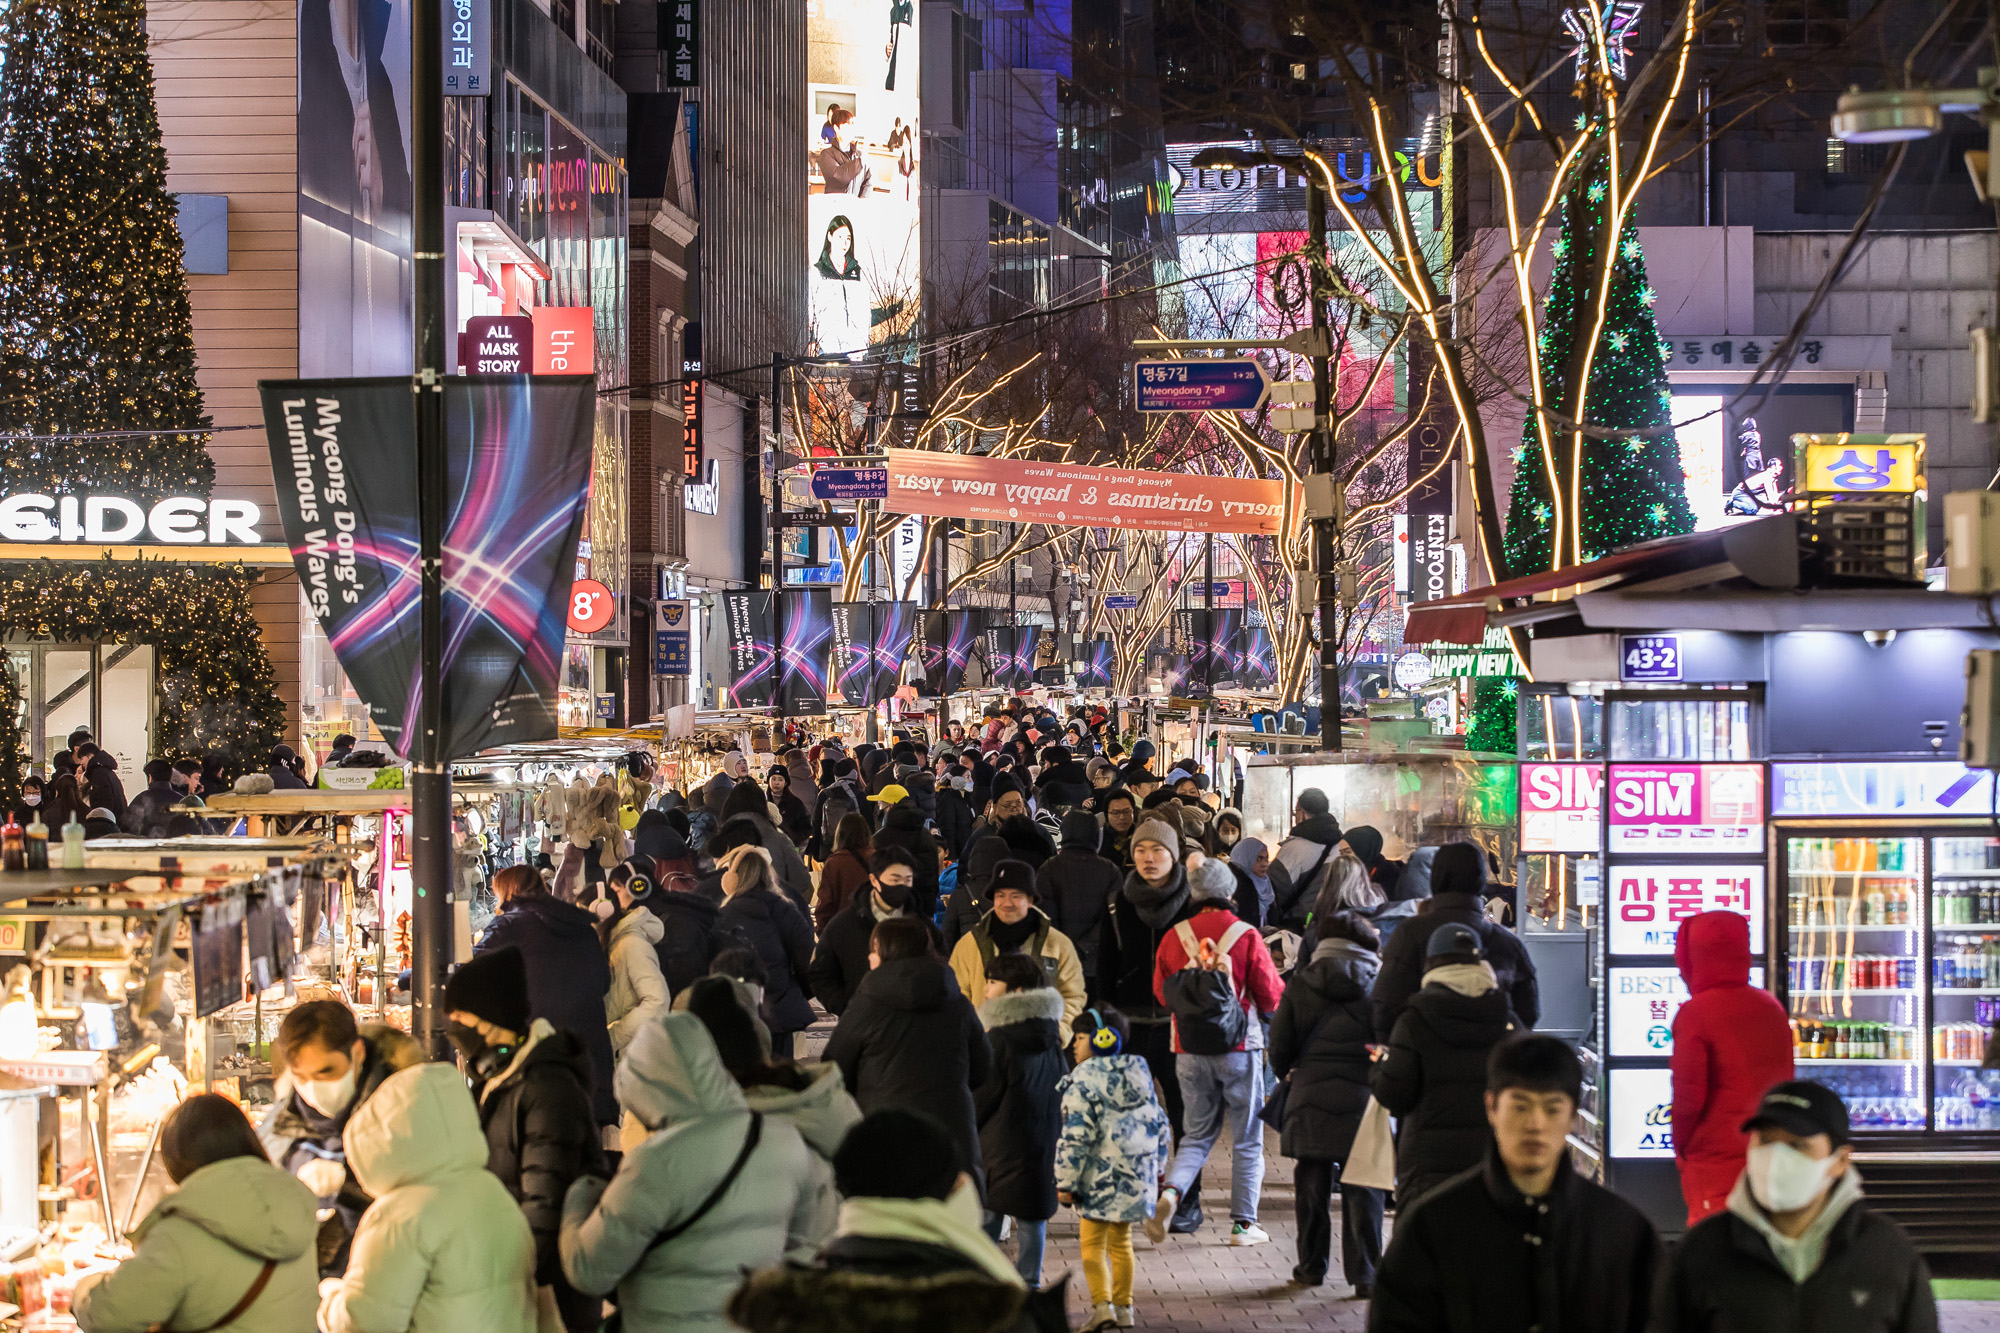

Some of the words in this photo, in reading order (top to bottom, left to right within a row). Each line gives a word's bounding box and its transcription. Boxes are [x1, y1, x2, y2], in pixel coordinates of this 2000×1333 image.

[675, 0, 692, 81] 세미소래
[487, 326, 512, 338] ALL
[480, 343, 519, 355] MASK
[551, 331, 575, 370] the
[1667, 341, 1823, 364] 동예술장
[478, 360, 520, 373] STORY
[1143, 366, 1188, 382] 명동7길
[1143, 386, 1201, 396] Myeongdong
[1204, 385, 1225, 396] 7-gil
[855, 471, 886, 481] 명동8길
[1826, 450, 1897, 490] 상
[870, 483, 886, 491] 8-gil
[283, 398, 320, 523] Luminous
[304, 529, 330, 618] Waves
[313, 398, 347, 506] Myeong
[334, 511, 364, 604] Dong's
[1415, 540, 1425, 564] 1957
[730, 596, 742, 639] Luminous
[840, 608, 848, 640] Myeong
[740, 596, 750, 633] Myeong
[745, 635, 755, 666] Dong's
[832, 608, 841, 643] Luminous
[837, 643, 845, 668] Waves
[1430, 654, 1476, 676] HAPPY
[1476, 654, 1510, 675] NEW
[1626, 648, 1676, 669] 43-2
[1614, 780, 1692, 818] SIM
[1619, 877, 1751, 922] 상품권
[1619, 976, 1676, 995] BEST
